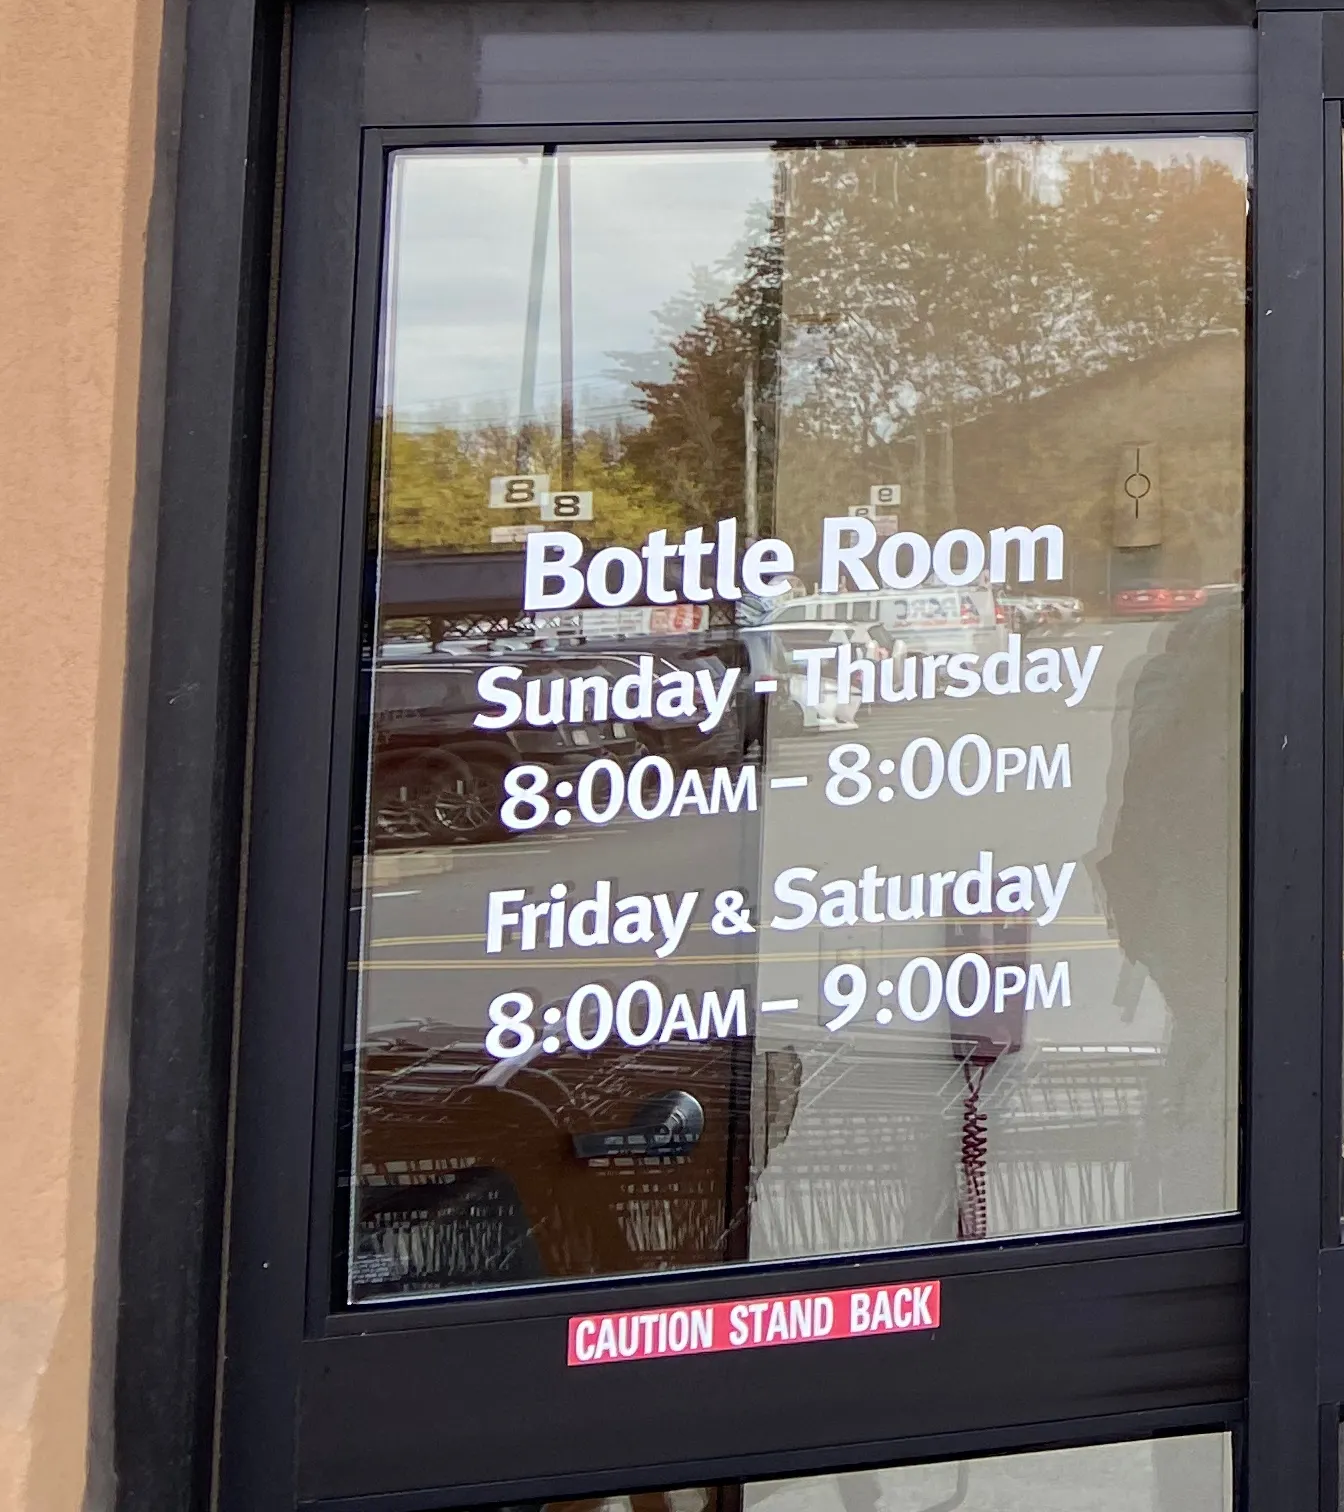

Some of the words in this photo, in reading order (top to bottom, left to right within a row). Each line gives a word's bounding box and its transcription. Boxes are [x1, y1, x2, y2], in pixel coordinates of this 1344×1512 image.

[524, 517, 795, 610] Bottle
[821, 516, 1064, 593] Room
[473, 656, 741, 733] Sunday
[792, 634, 1104, 708] Thursday
[500, 755, 758, 830] 8:00AM
[824, 733, 1072, 806] 8:00PM
[485, 880, 699, 959] Friday
[710, 889, 757, 935] &
[770, 850, 1077, 928] Saturday
[485, 980, 747, 1059] 8:00AM
[822, 952, 1072, 1032] 9:00PM
[575, 1308, 714, 1361] CAUTION
[729, 1296, 834, 1346] STAND
[850, 1285, 934, 1333] BACK
